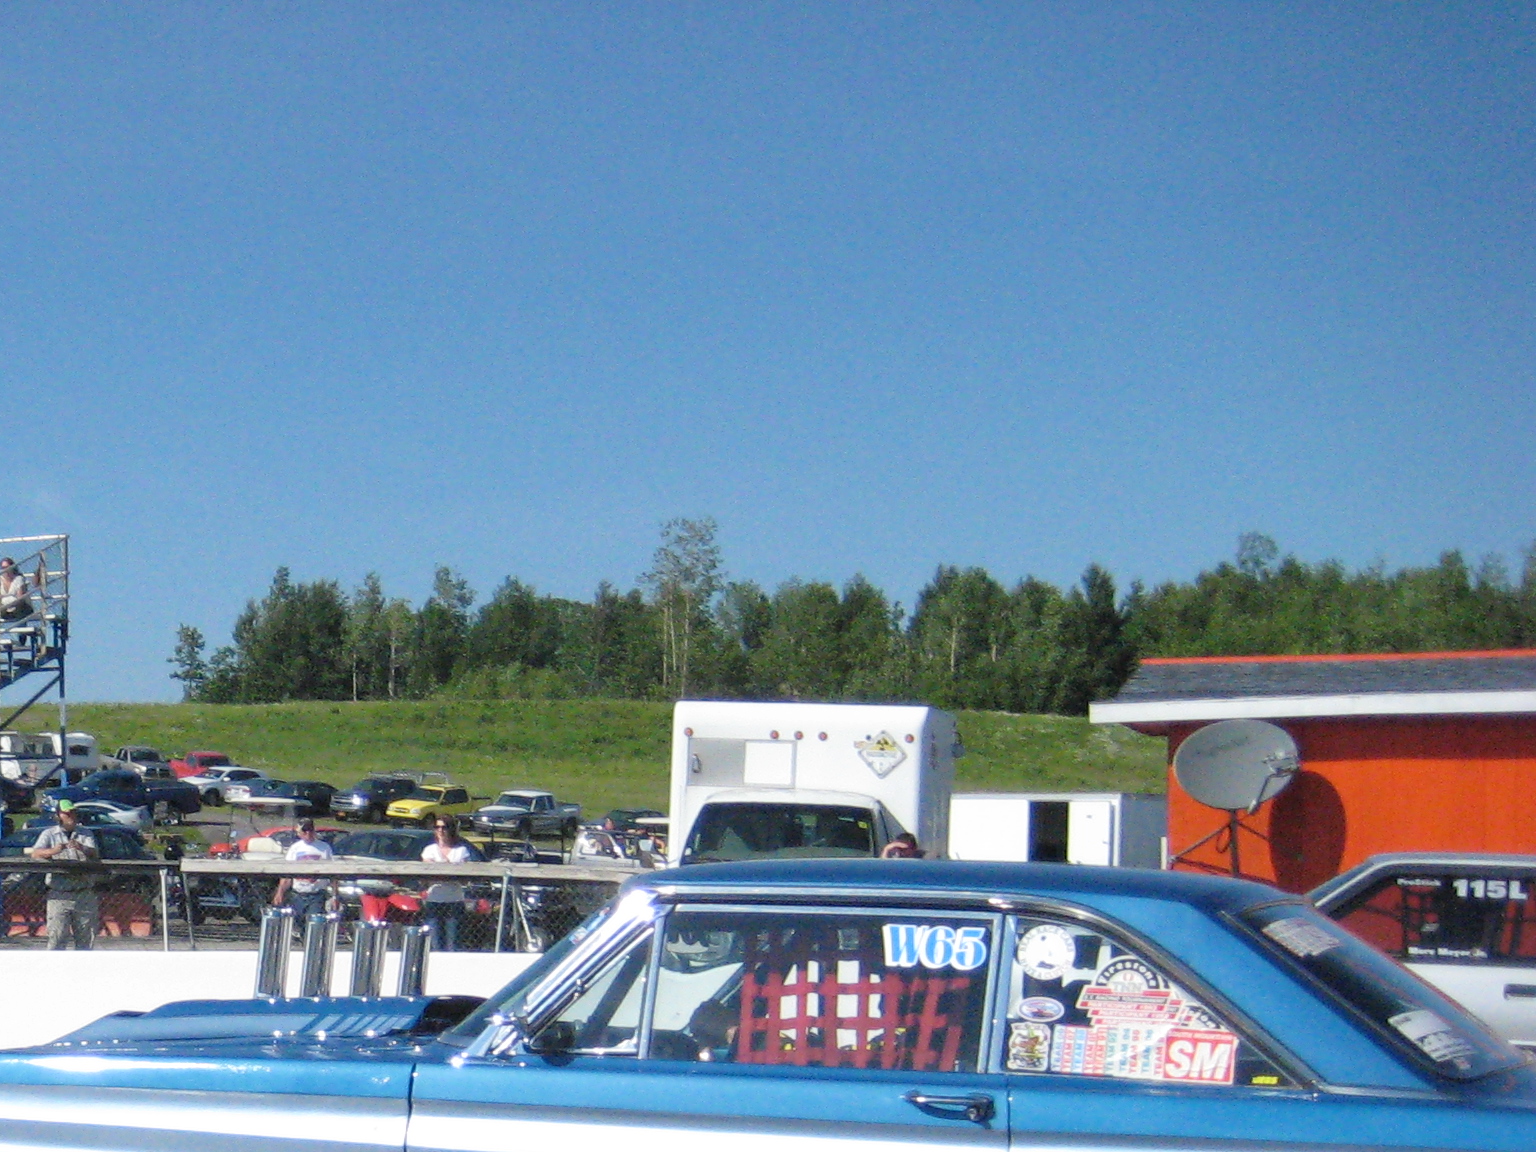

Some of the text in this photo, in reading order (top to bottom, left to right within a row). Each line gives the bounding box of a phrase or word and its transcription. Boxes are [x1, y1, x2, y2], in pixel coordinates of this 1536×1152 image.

[1452, 878, 1529, 900] 115L
[882, 923, 988, 971] W65
[1097, 961, 1158, 988] Firestone
[1165, 1039, 1233, 1080] SM
